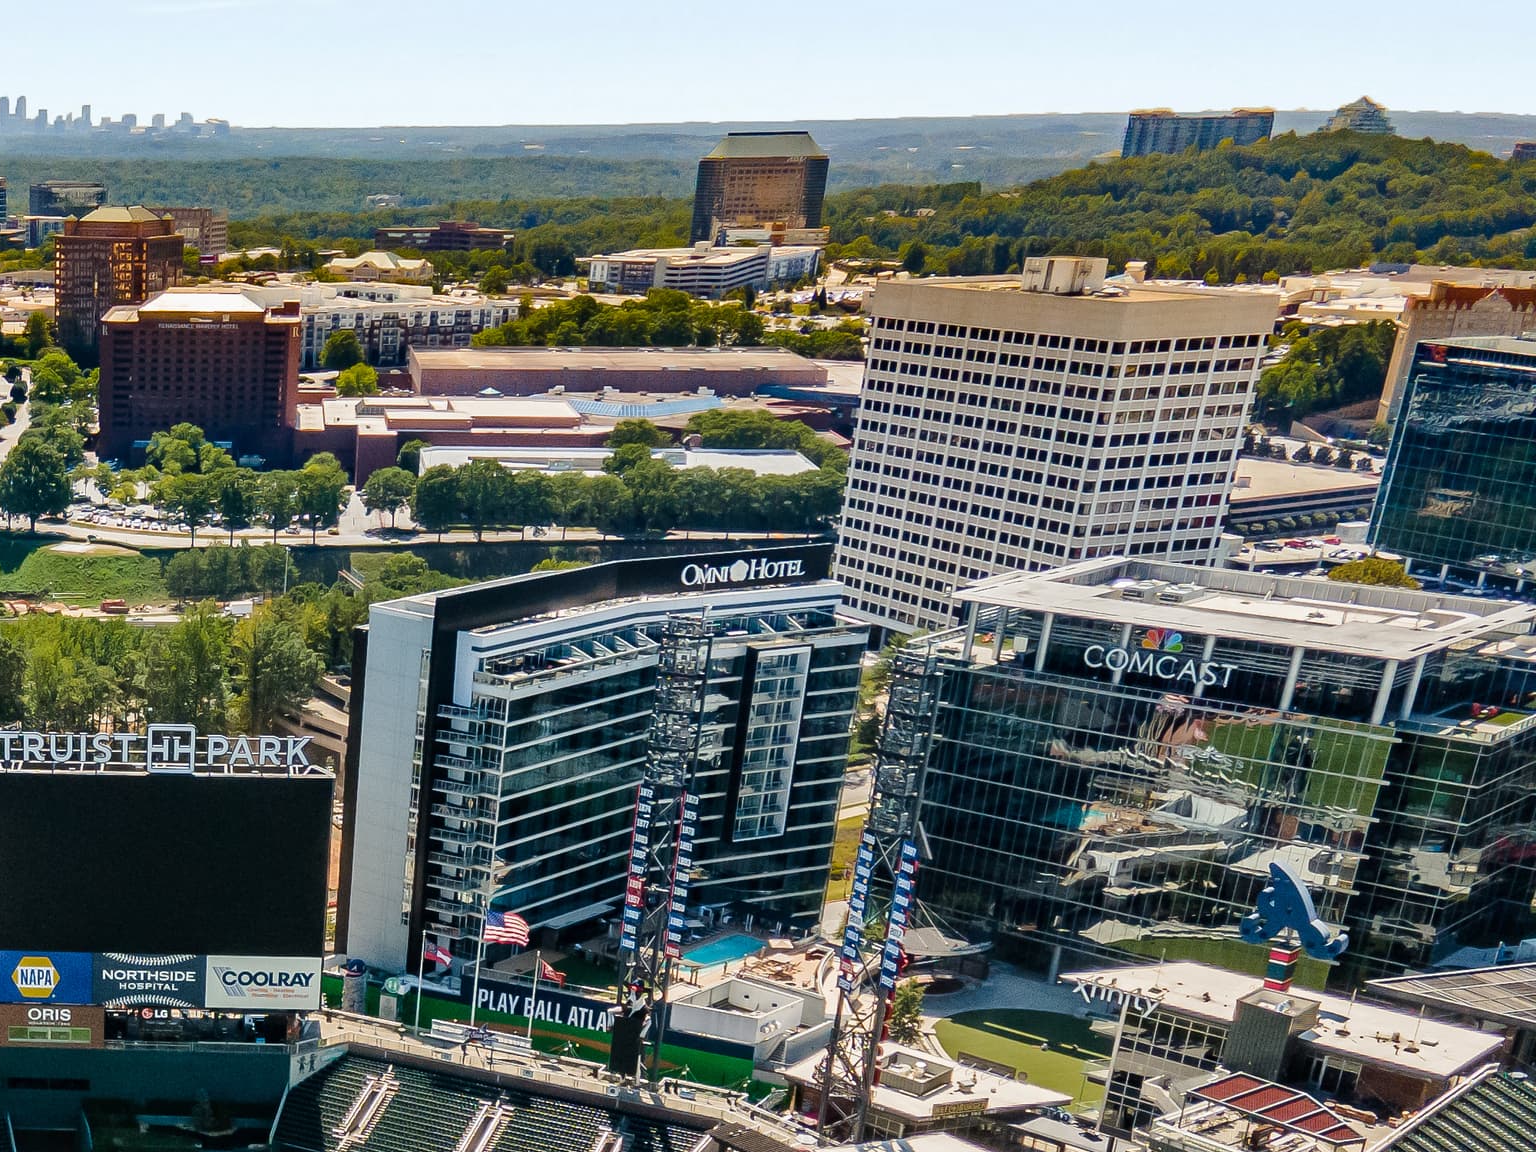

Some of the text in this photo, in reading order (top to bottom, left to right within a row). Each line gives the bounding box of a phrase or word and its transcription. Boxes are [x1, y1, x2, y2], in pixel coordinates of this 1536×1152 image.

[748, 558, 805, 580] HOTEL
[1084, 645, 1238, 688] COMCAST
[207, 734, 314, 766] PARK
[19, 969, 53, 987] NAPA
[102, 969, 196, 982] NORTHSIDE
[221, 970, 315, 987] COOLRAY
[119, 982, 178, 991] HOSPITAL
[154, 1010, 168, 1018] LG
[477, 988, 520, 1014] PLAY
[523, 997, 563, 1024] BALL
[28, 1008, 72, 1022] ORIS
